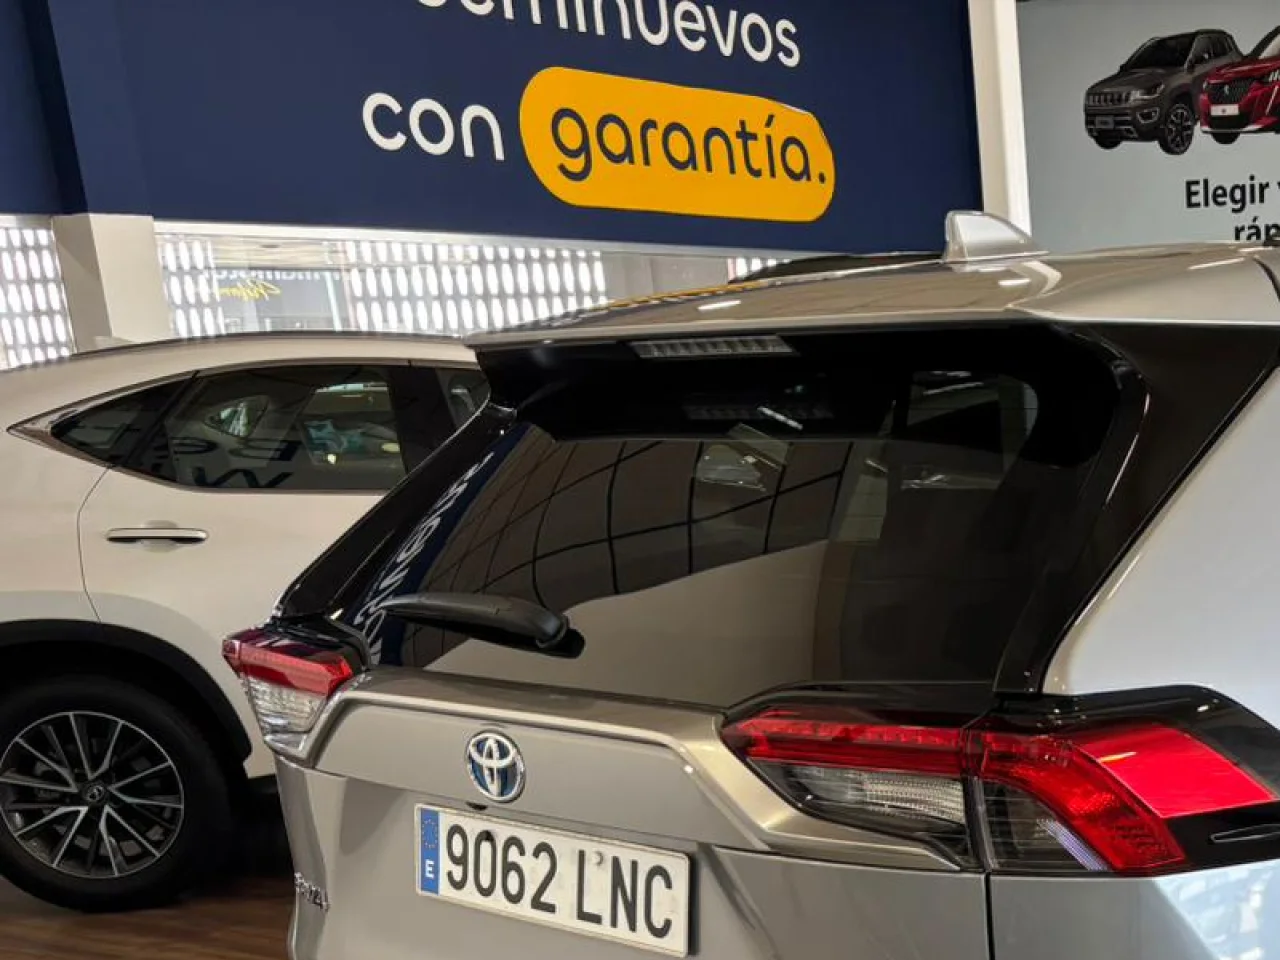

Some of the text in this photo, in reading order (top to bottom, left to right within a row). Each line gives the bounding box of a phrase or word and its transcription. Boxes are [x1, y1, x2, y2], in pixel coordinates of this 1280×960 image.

[362, 92, 827, 183] con garantía.
[1185, 174, 1270, 213] Elegir
[425, 859, 434, 879] E
[446, 823, 673, 938] 9062 LNC
